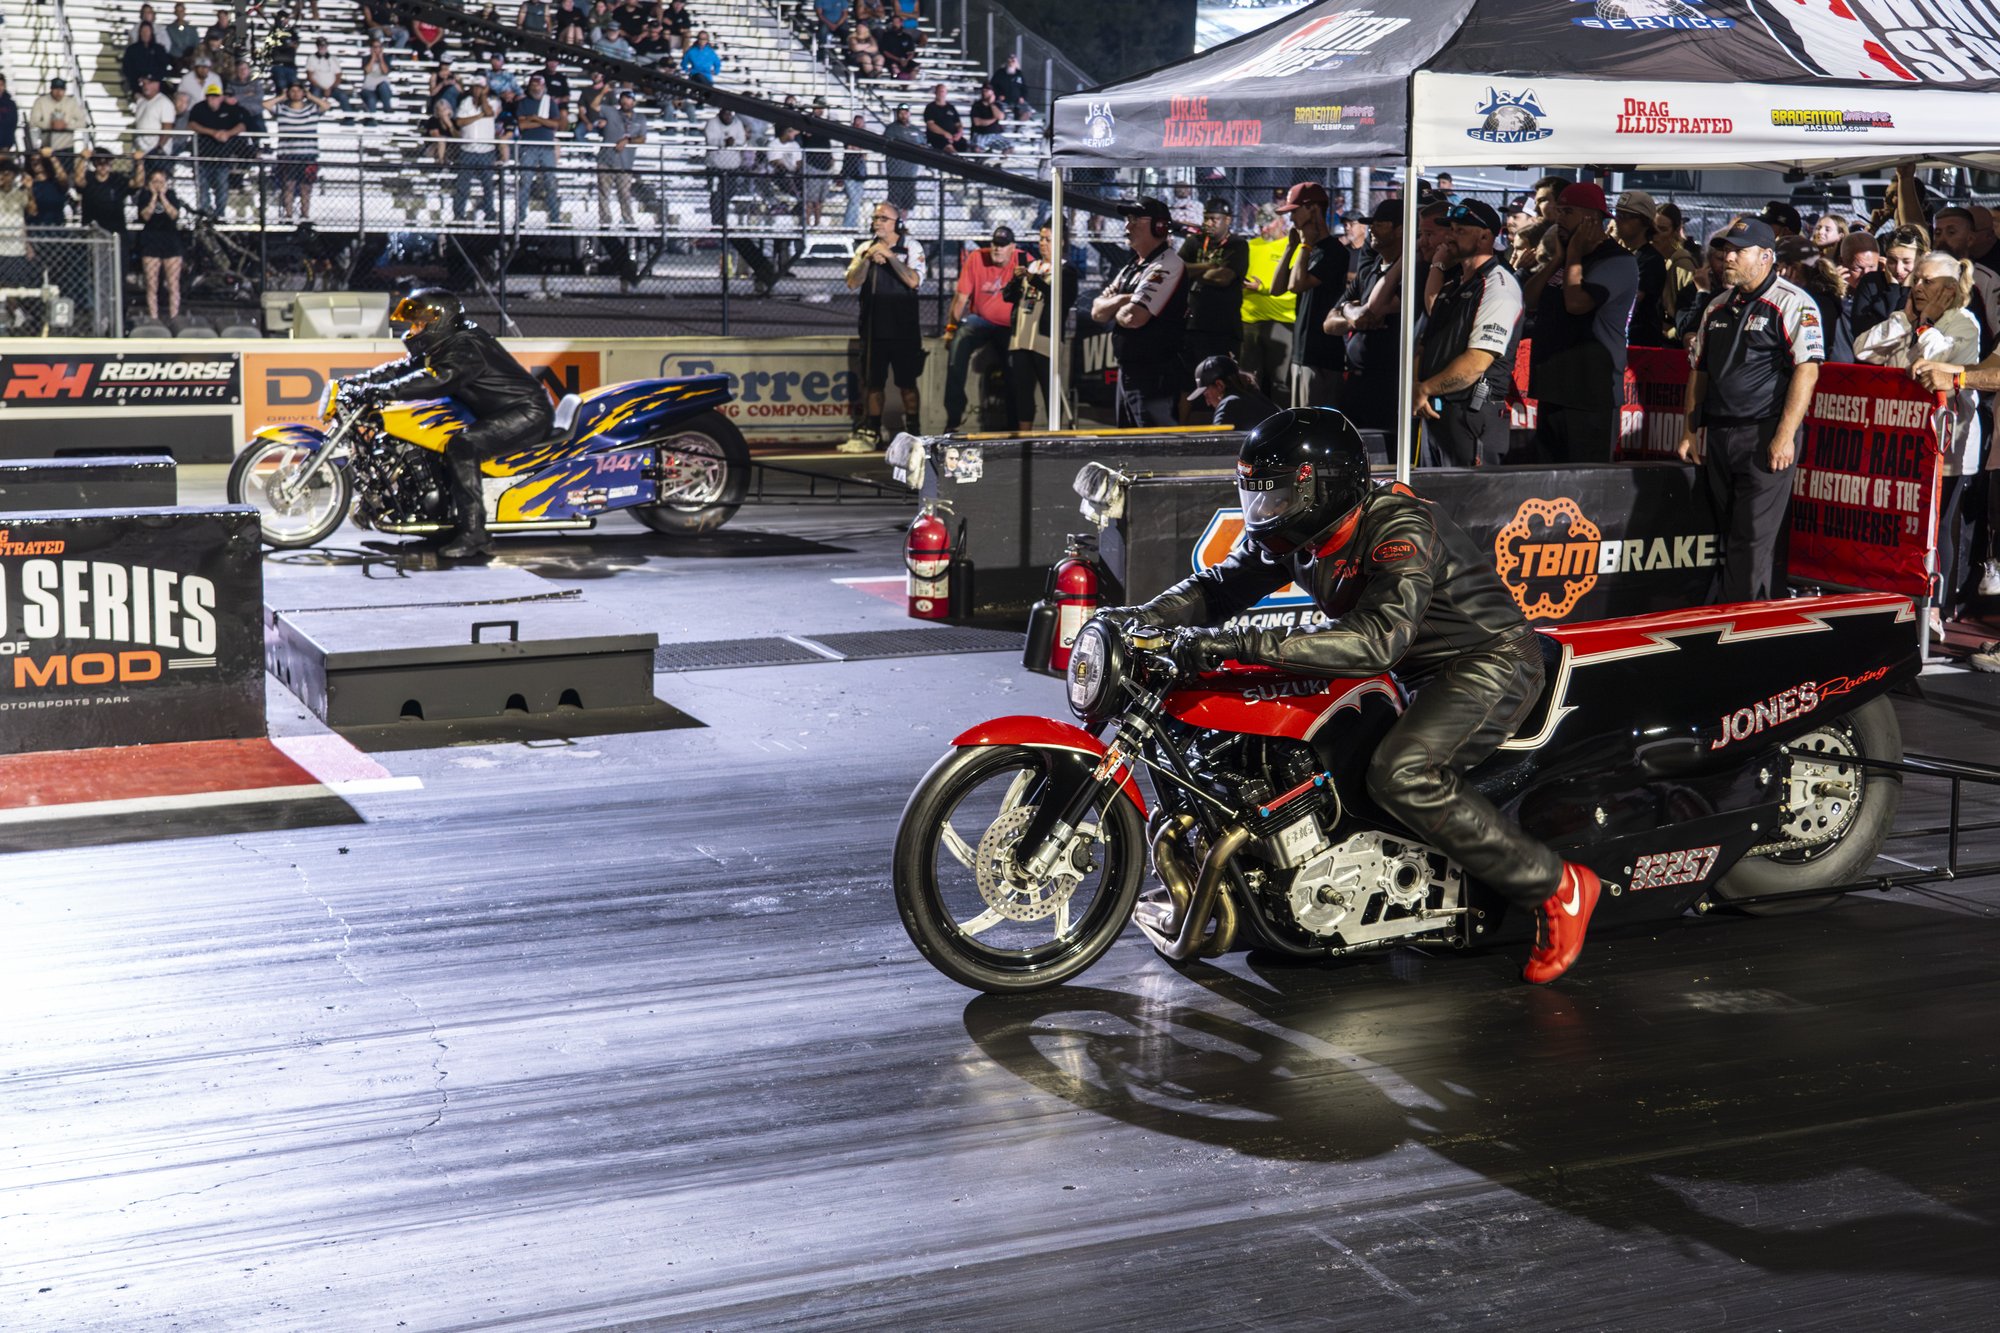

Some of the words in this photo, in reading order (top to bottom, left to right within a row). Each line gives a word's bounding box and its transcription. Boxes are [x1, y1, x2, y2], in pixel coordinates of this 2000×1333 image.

[1581, 17, 1730, 30] SERVICE
[1170, 95, 1209, 121] DRAG
[1474, 86, 1546, 116] J&A
[1623, 98, 1669, 117] DRAG
[1616, 114, 1733, 133] ILLUSTRATED
[1771, 109, 1843, 125] BRADENTON
[1083, 136, 1115, 148] SERVICE
[1163, 118, 1262, 147] ILLUSTRATED
[1470, 130, 1549, 143] SERVICE
[100, 361, 235, 381] REDHORSE
[677, 360, 862, 402] rrea
[92, 386, 227, 398] PERFORMANCE
[747, 404, 863, 417] COMPONENTS
[1814, 392, 1870, 428] BIGGEST,
[1873, 398, 1932, 430] RICHEST
[596, 454, 644, 475] 1447
[1814, 426, 1864, 473] MOD
[1870, 432, 1925, 480] RACE
[1809, 470, 1871, 506] HISTORY
[1873, 479, 1892, 509] OF
[1895, 481, 1922, 512] THE
[1823, 506, 1902, 547] UNIVERSE
[22, 558, 217, 656] SERIES
[1222, 611, 1297, 631] RACING
[0, 641, 30, 655] OF
[14, 651, 162, 688] MOD
[96, 696, 130, 705] PARK
[1243, 679, 1330, 706] SUZUKI
[1711, 681, 1820, 750] JONES
[1814, 665, 1889, 701] Racing
[1630, 845, 1721, 891] 32257
